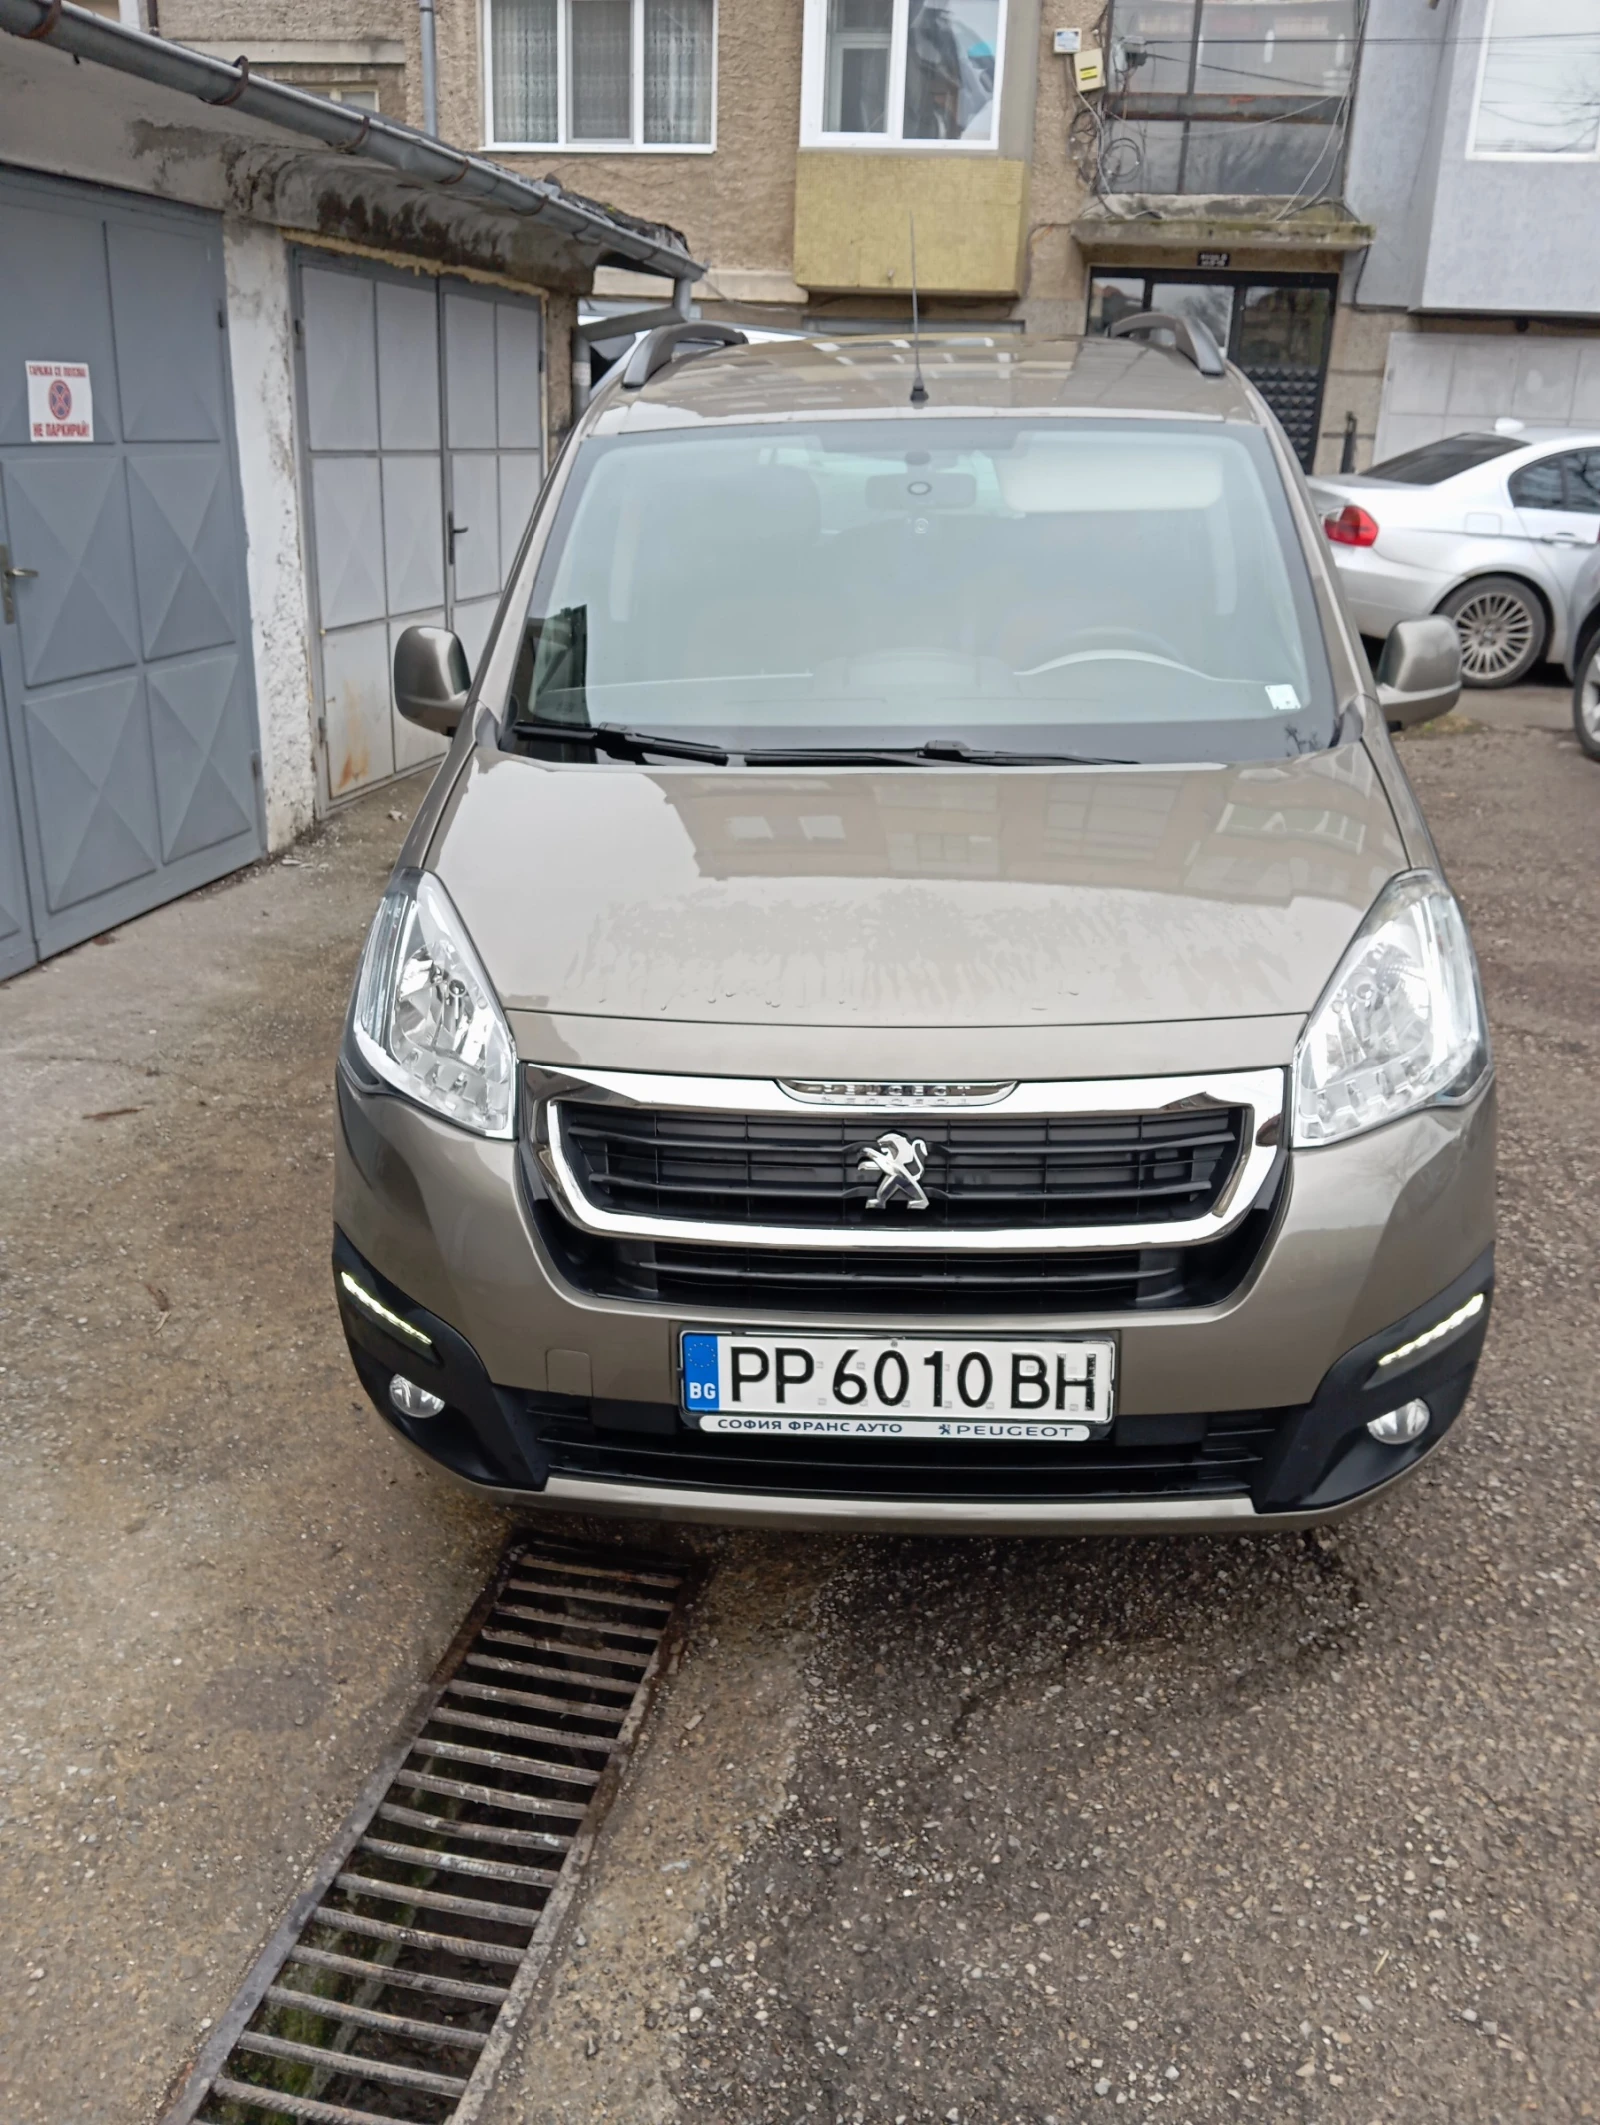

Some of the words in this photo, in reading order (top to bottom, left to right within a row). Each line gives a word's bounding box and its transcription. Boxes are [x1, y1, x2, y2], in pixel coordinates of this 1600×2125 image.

[54, 366, 62, 377] СЕ
[33, 423, 44, 437] НЕ
[832, 1348, 993, 1408] 6010
[689, 1381, 717, 1400] BG
[717, 1418, 782, 1430] СОФИЯ
[788, 1420, 850, 1432] ФРАНС
[856, 1422, 903, 1434] АУТО
[956, 1424, 1075, 1437] PEUGEOT
